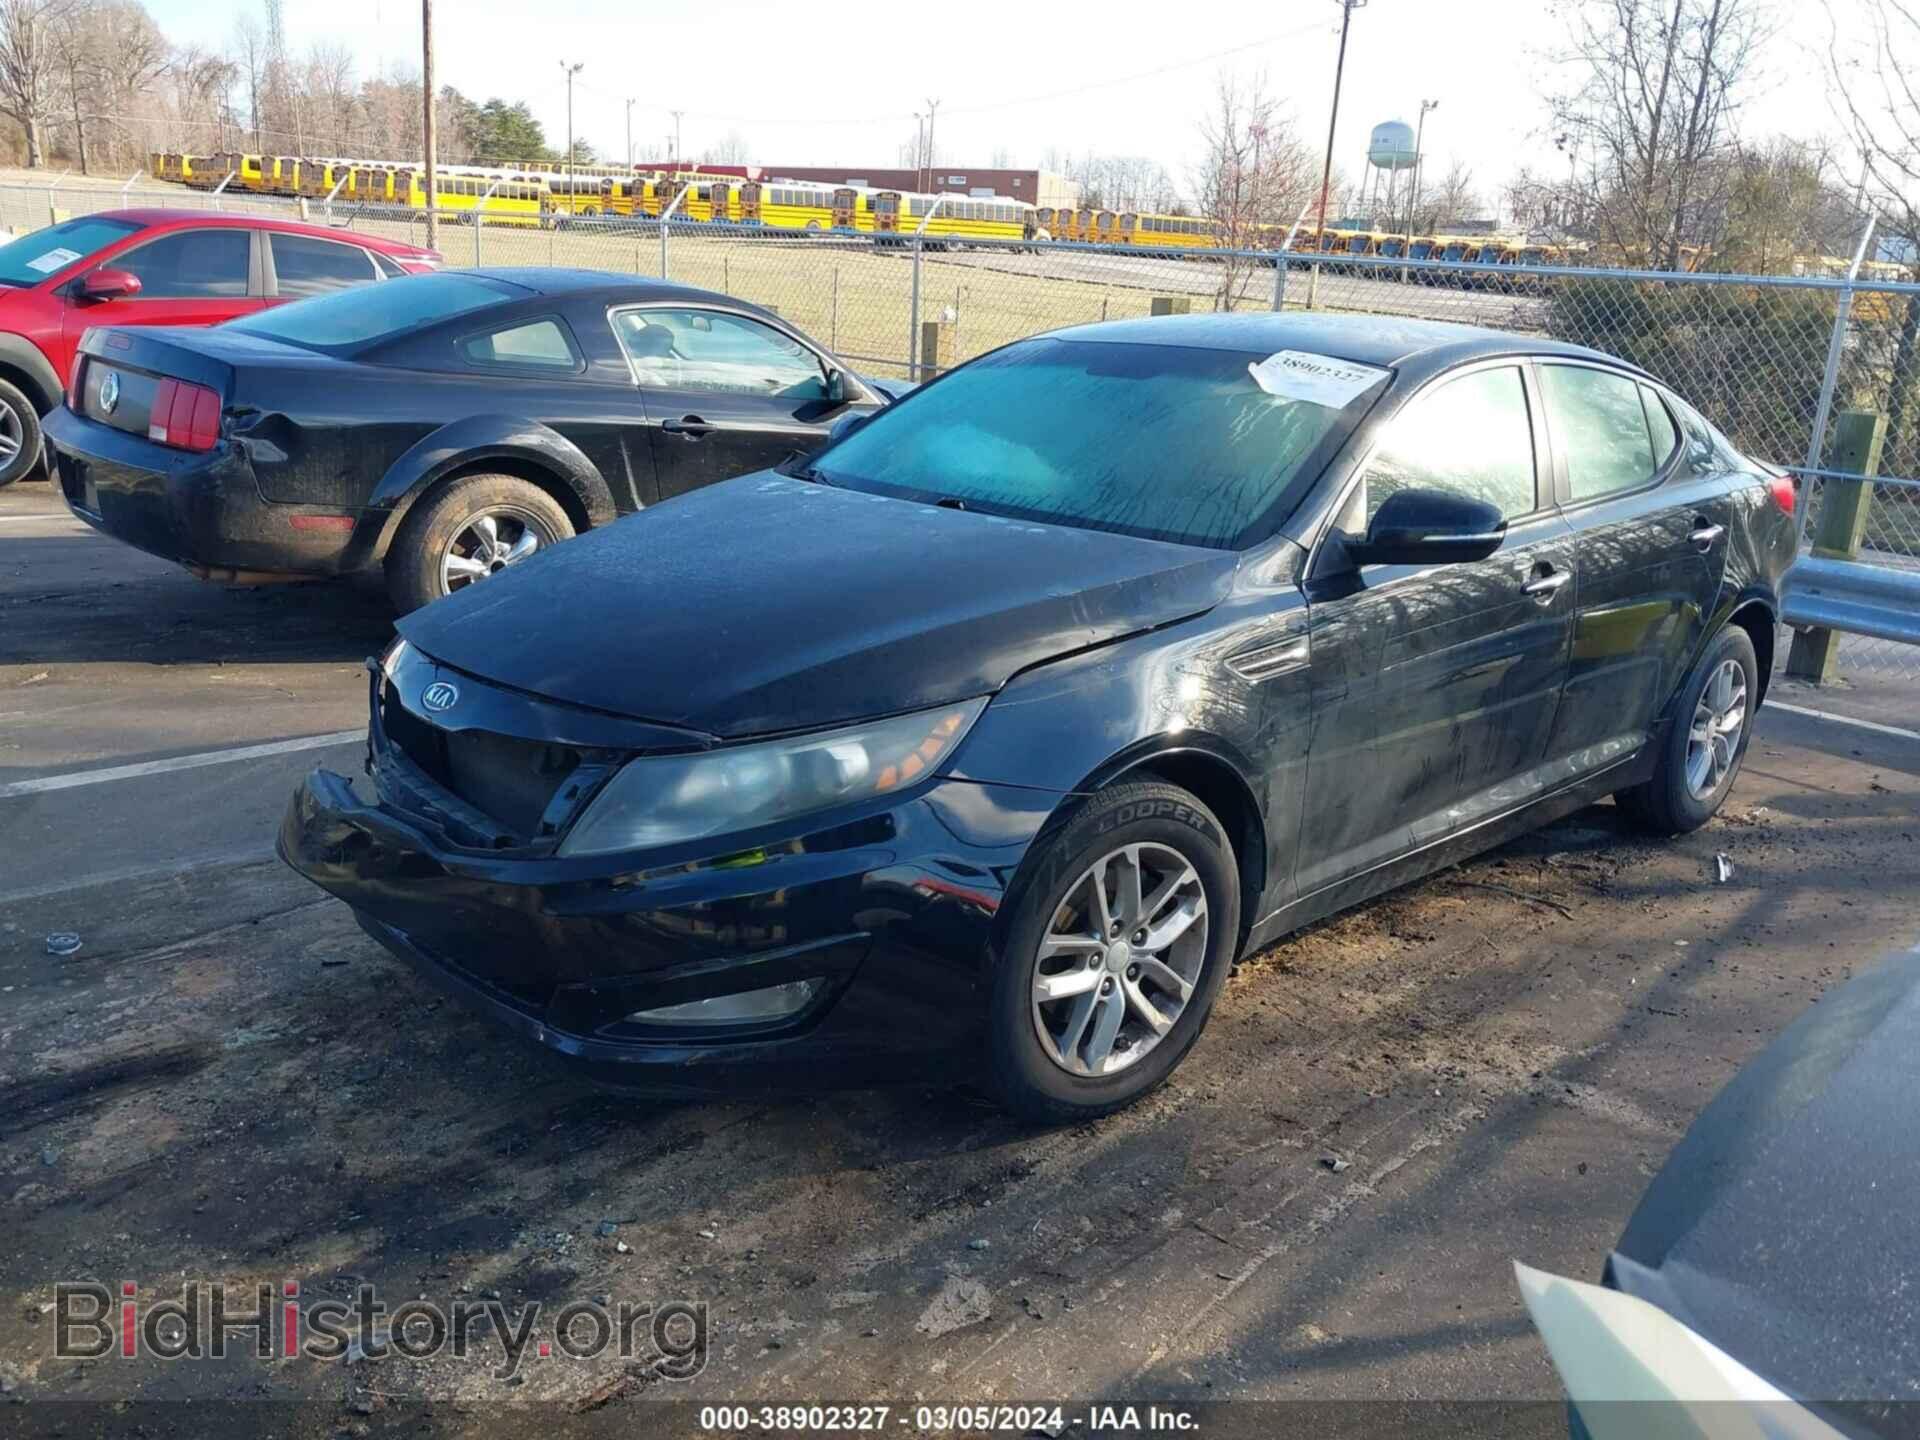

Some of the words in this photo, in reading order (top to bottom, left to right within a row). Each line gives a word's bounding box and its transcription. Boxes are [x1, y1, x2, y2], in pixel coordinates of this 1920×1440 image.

[1282, 357, 1364, 383] 38902327
[425, 686, 451, 708] KIA
[1098, 801, 1207, 834] COOPER
